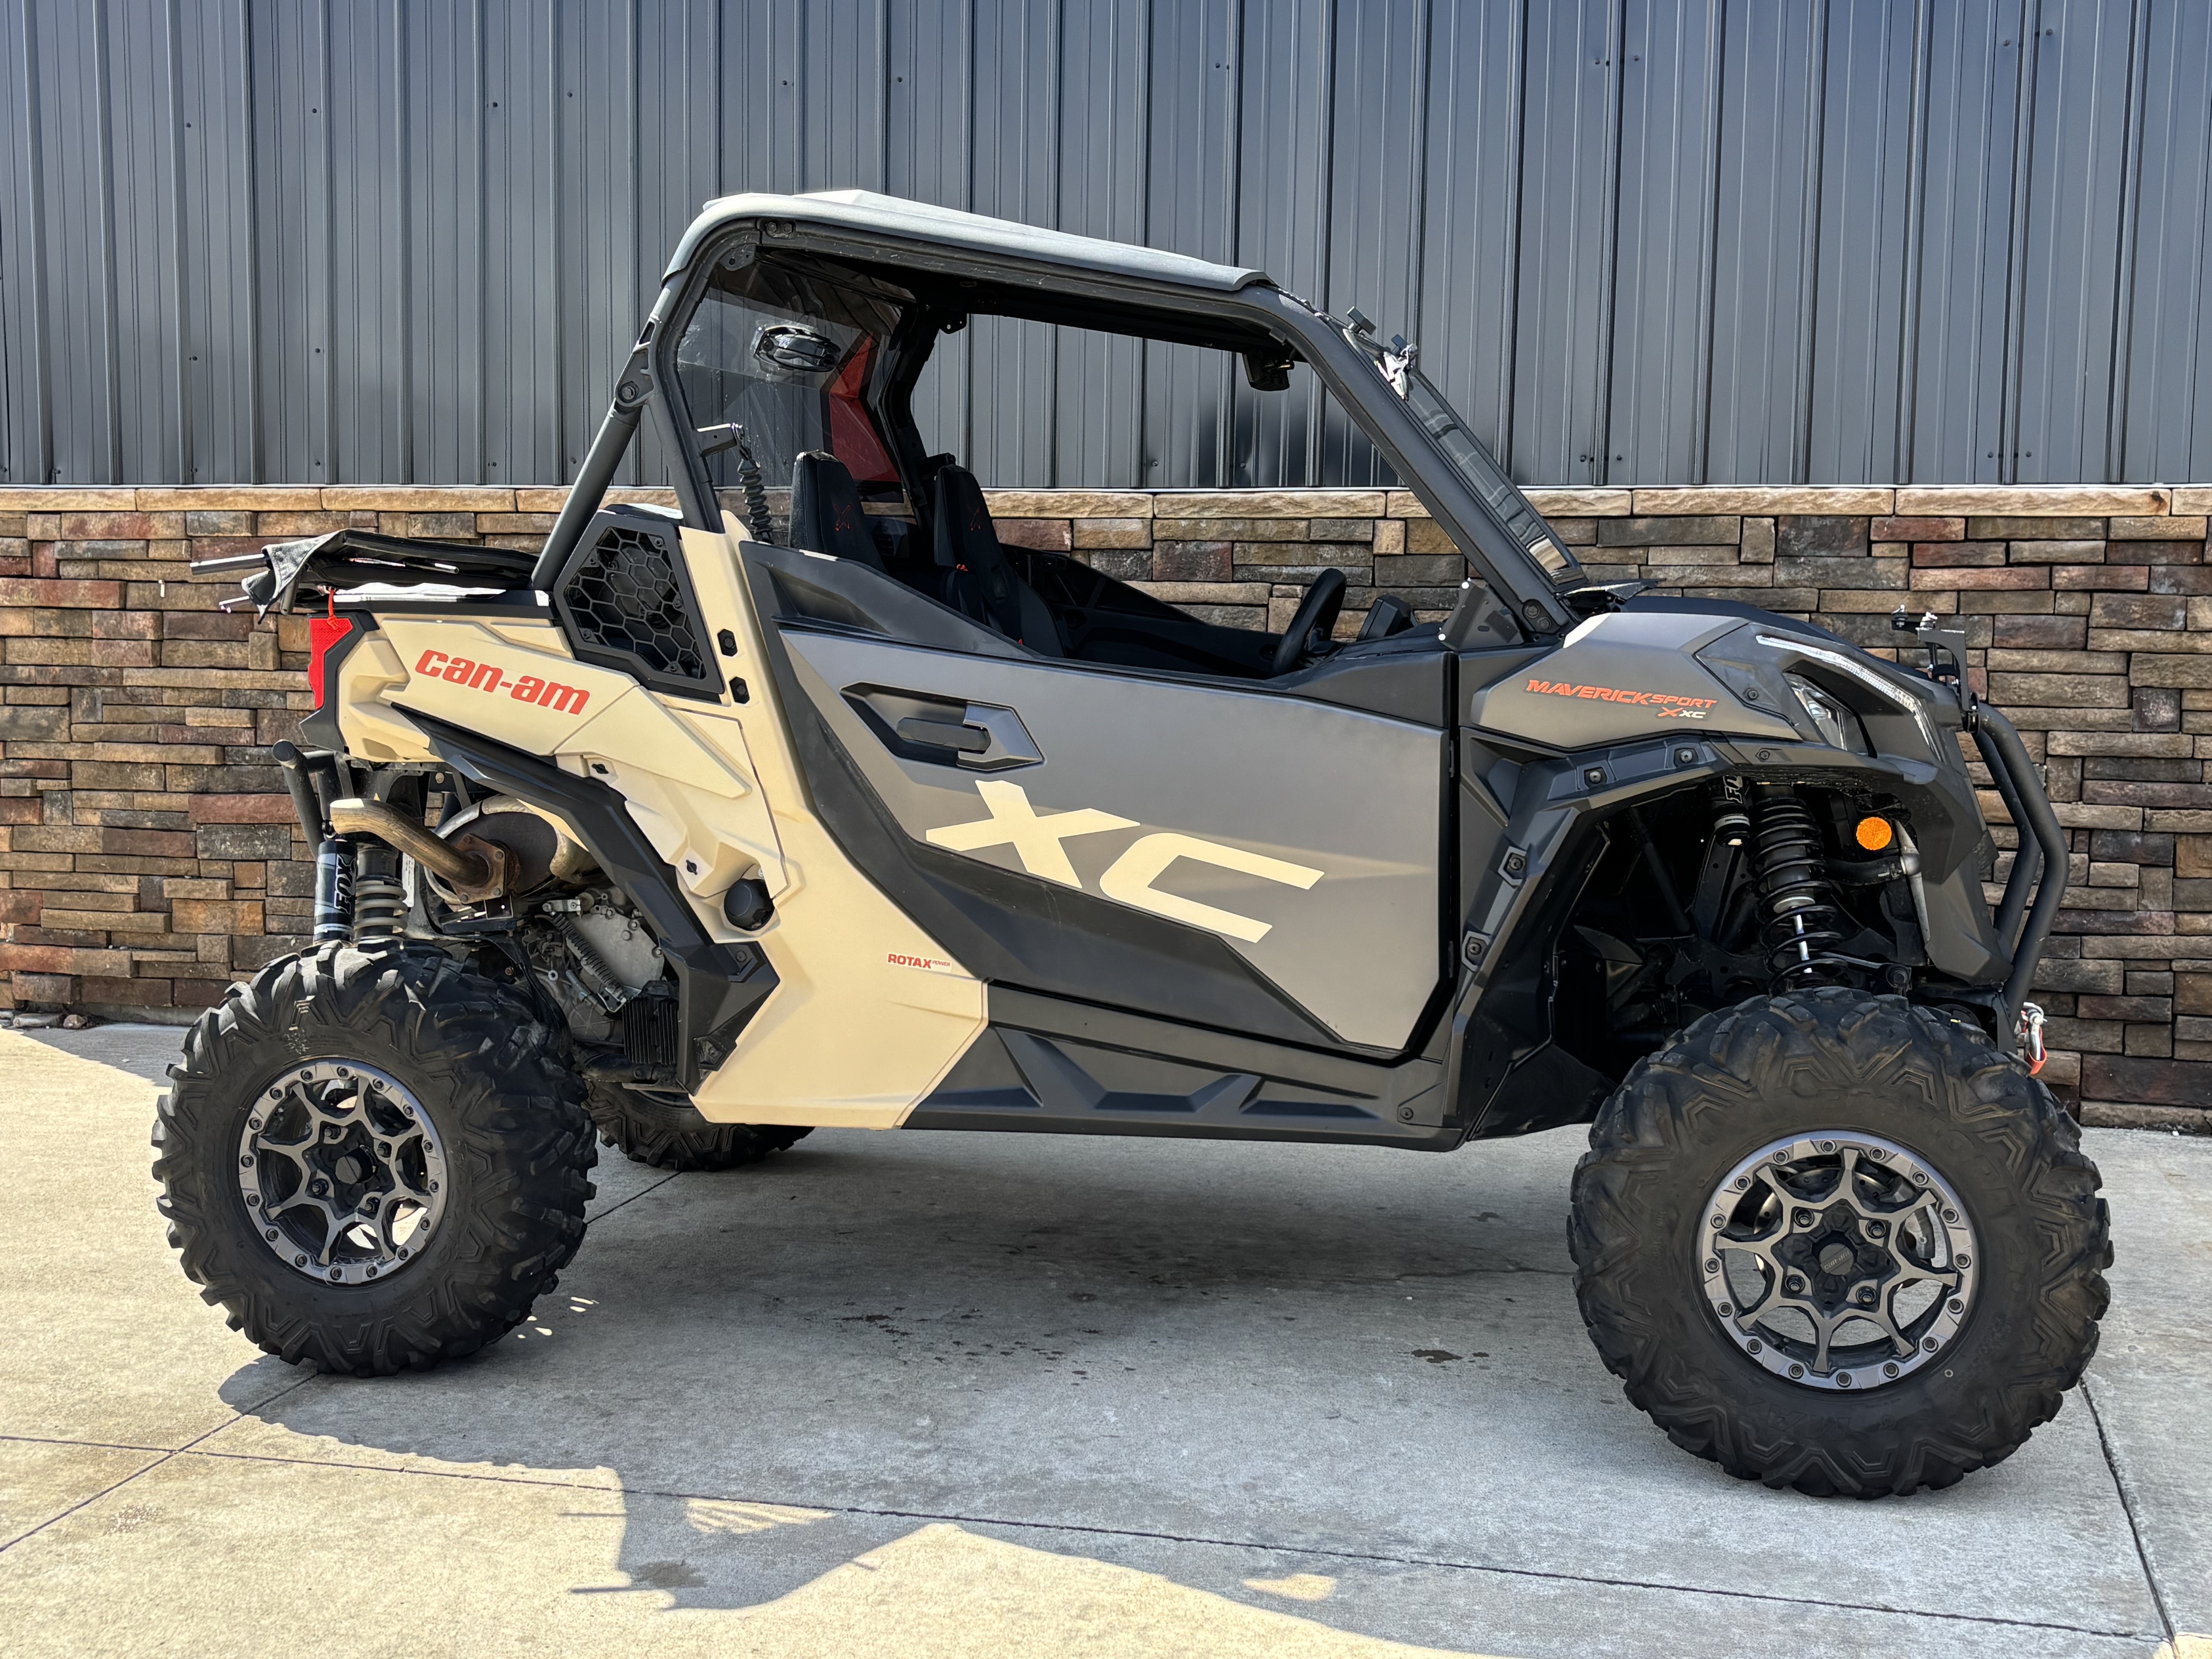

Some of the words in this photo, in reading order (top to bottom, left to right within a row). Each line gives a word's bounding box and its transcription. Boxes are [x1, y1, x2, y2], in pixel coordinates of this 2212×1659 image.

[415, 649, 590, 715] can-am
[1526, 680, 1652, 705] MAVERICK
[1650, 694, 1717, 708] SPORT
[1723, 775, 1743, 804] FO
[334, 853, 356, 915] FOX
[926, 780, 1324, 943] XC
[888, 954, 932, 969] ROTAX
